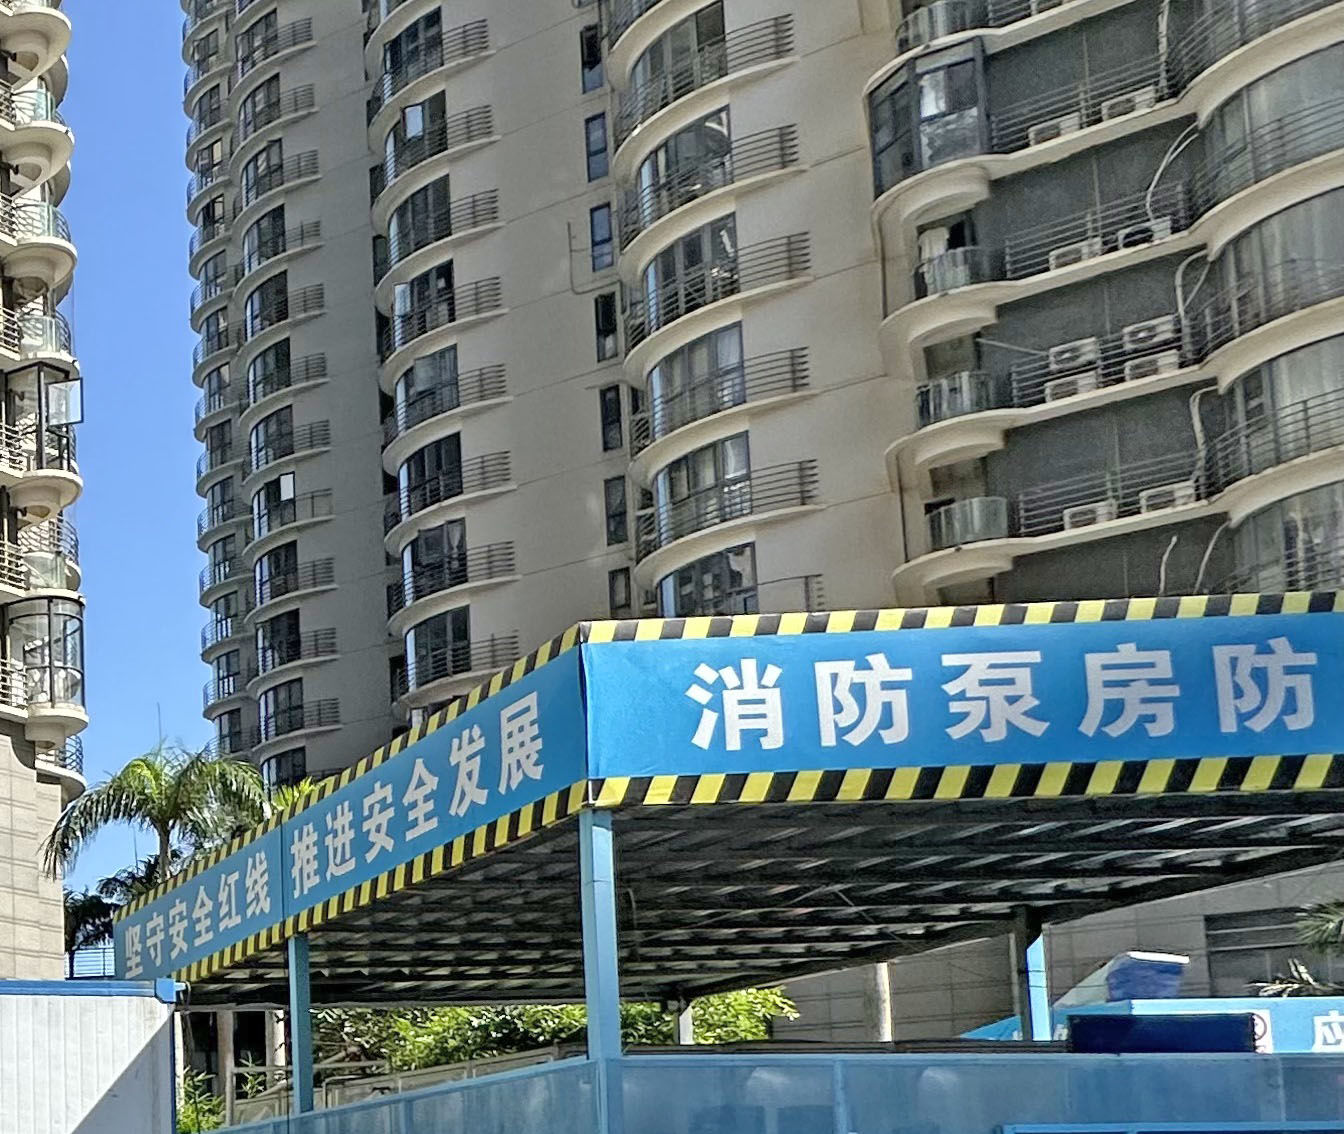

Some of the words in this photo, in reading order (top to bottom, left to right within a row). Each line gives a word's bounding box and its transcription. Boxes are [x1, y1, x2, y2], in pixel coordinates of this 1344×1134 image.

[685, 636, 1318, 752] 消防泵房防
[124, 850, 272, 979] 坚守安全红线
[290, 690, 545, 899] 推进安全发展
